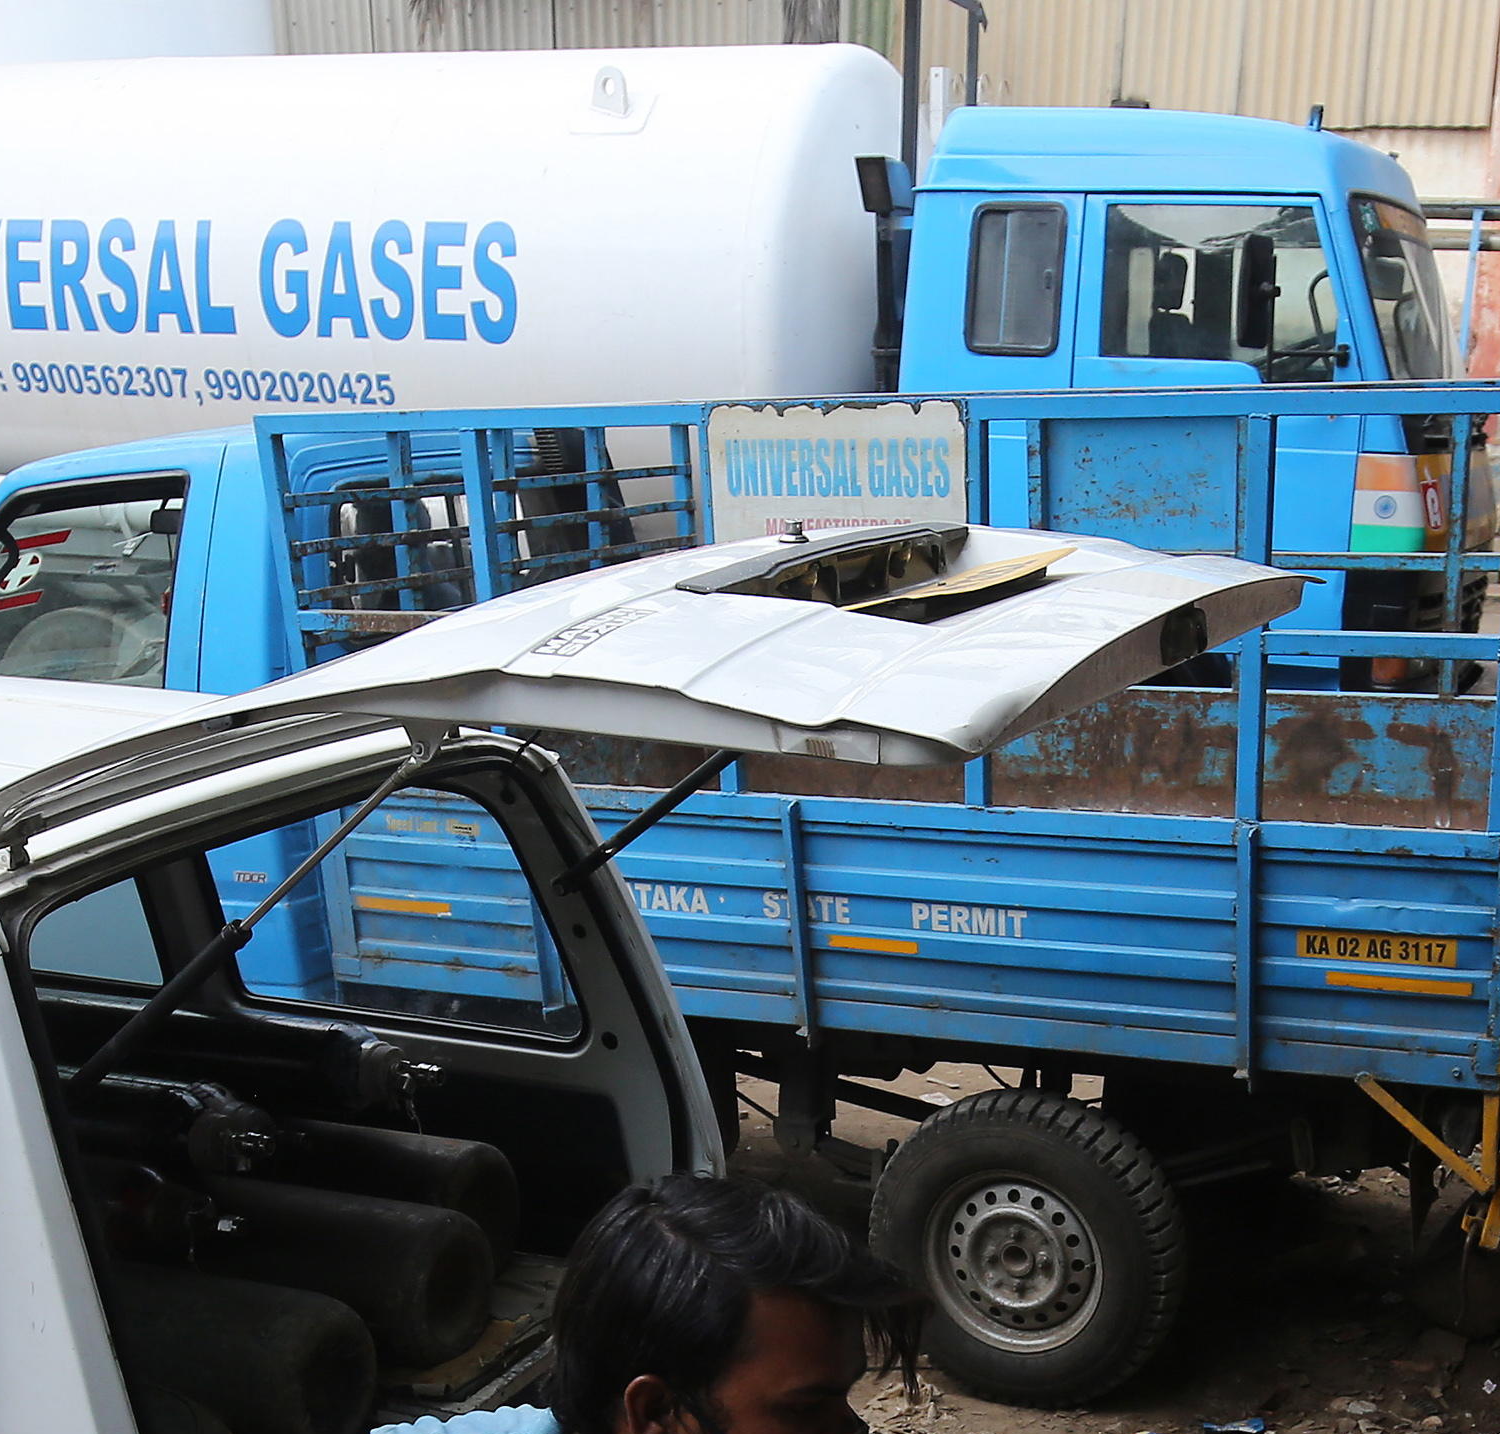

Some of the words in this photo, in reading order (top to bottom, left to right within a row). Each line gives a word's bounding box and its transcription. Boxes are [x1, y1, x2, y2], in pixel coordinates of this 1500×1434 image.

[258, 217, 519, 345] GASES
[725, 437, 862, 498] UNIVERSAL
[868, 437, 950, 498] GASES
[765, 518, 888, 536] MAFACTU
[628, 883, 710, 915] TAKA
[911, 902, 1028, 938] PERMIT
[1306, 935, 1330, 955] KA
[1336, 937, 1361, 957] 02
[1366, 939, 1392, 960] AG
[1399, 941, 1447, 963] 3117
